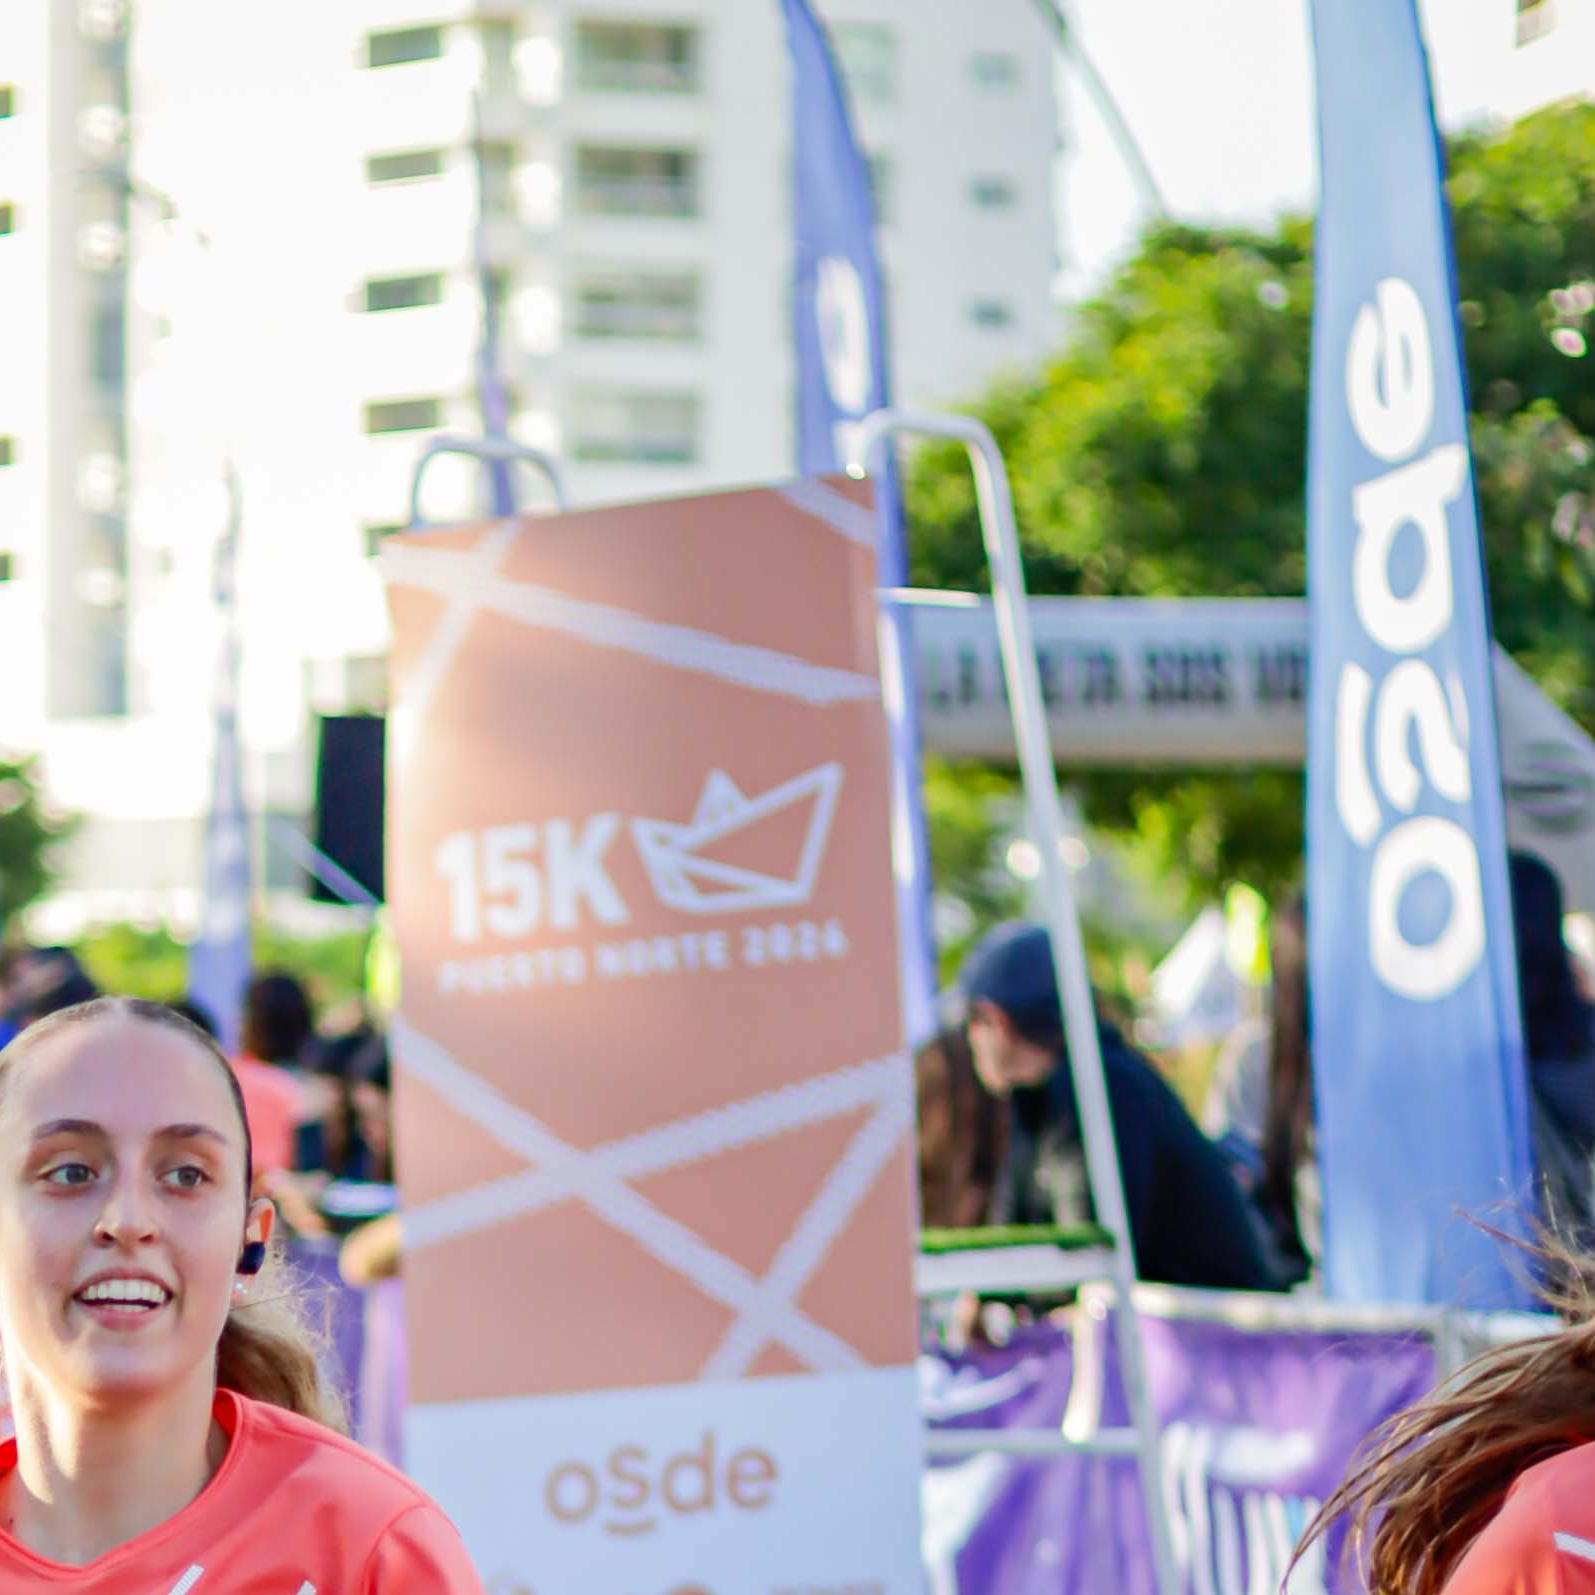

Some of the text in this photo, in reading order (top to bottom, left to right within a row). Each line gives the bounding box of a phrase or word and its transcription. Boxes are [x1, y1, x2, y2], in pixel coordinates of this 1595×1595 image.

[1336, 277, 1487, 998] osde
[433, 812, 630, 942] 15K
[438, 946, 586, 996] PUERTO
[596, 931, 729, 980] NORTE
[544, 1430, 779, 1536] osde
